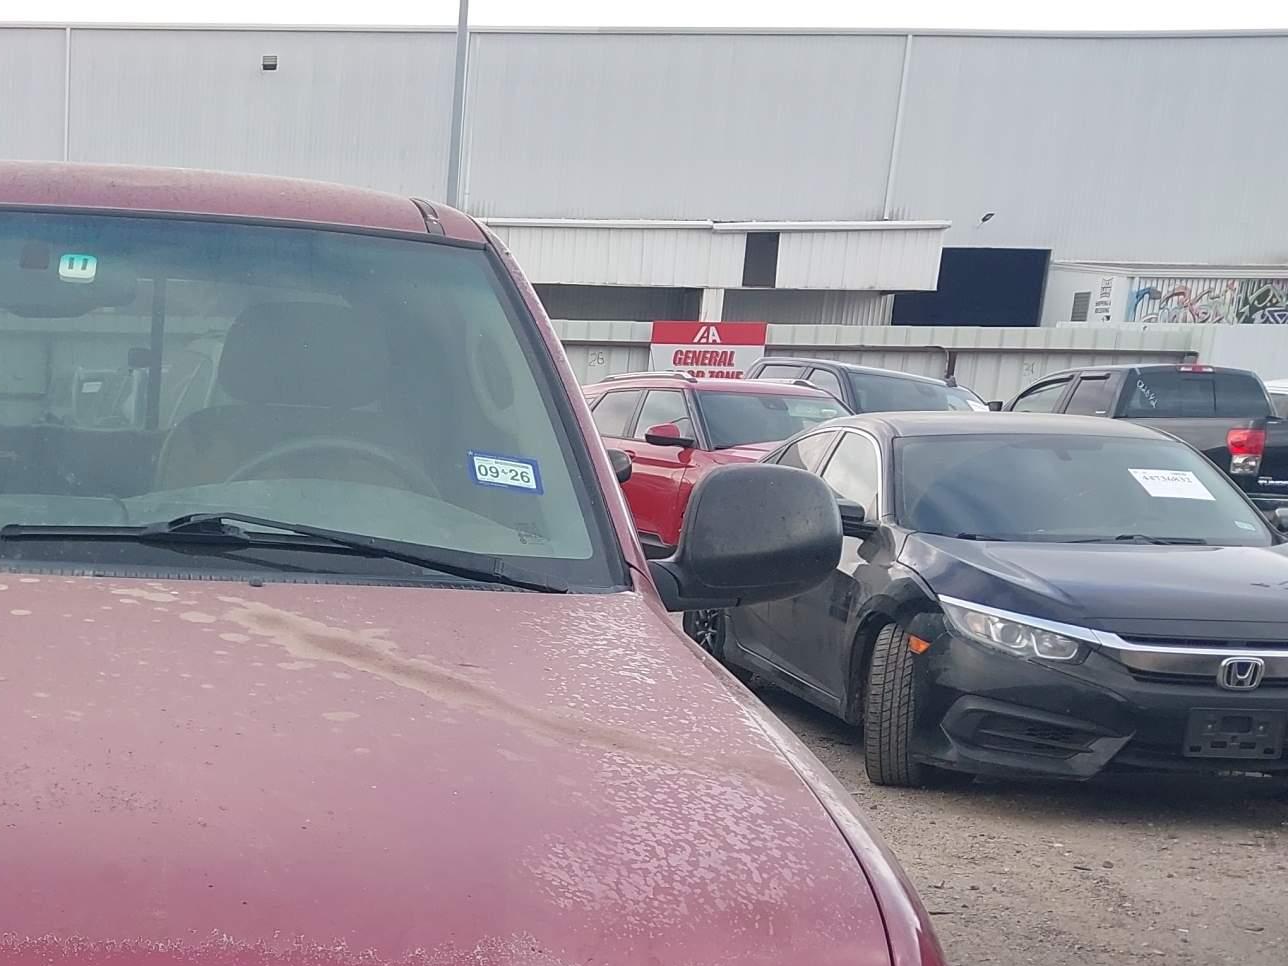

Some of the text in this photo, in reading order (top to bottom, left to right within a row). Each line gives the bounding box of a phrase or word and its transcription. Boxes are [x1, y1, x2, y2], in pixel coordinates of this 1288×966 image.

[672, 349, 736, 367] GENERAL
[477, 464, 500, 479] 09
[508, 468, 531, 484] 26
